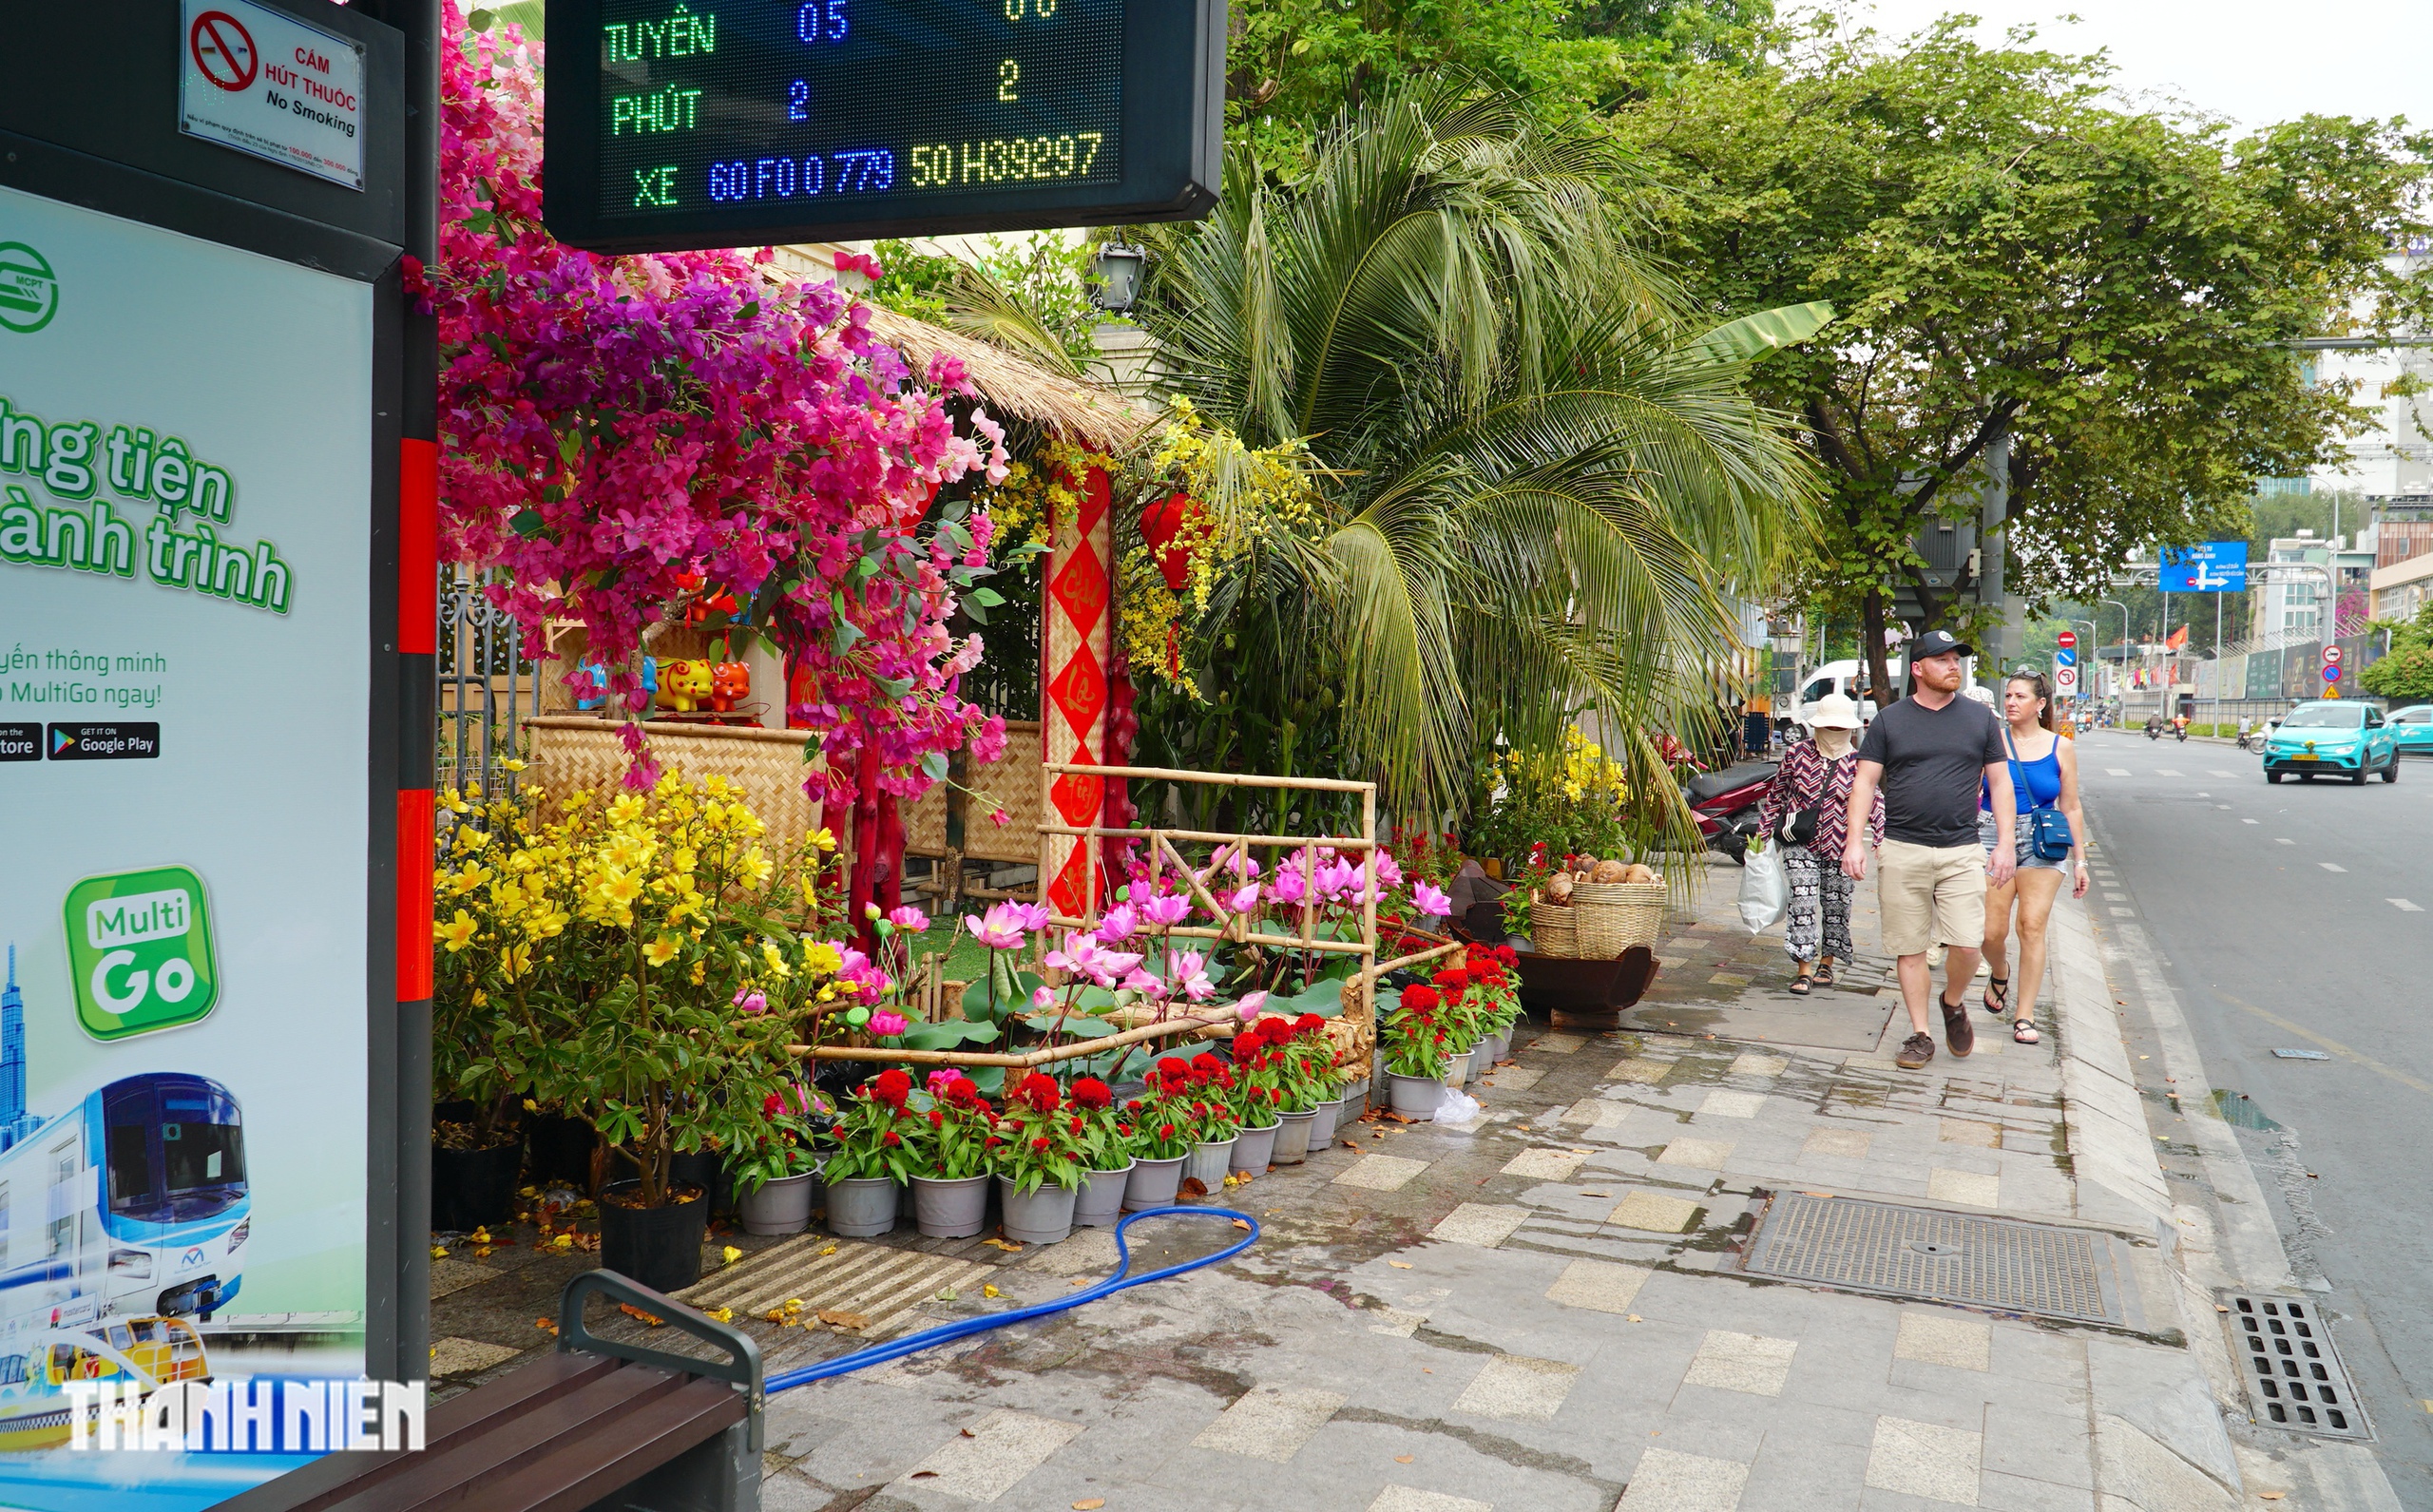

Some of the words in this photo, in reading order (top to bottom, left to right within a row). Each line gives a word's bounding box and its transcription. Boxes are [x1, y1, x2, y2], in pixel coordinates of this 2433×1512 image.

[295, 47, 330, 75] CẤM
[265, 62, 298, 89] HÚT
[302, 76, 357, 112] THUỐC
[614, 83, 703, 135] PHÚT
[789, 80, 808, 120] 2
[998, 59, 1020, 101] 2
[266, 89, 288, 110] No
[292, 100, 356, 138] Smoking
[288, 146, 313, 160] 100.000
[323, 159, 346, 172] 300.000
[634, 165, 679, 207] XE
[15, 275, 44, 289] MCPT
[105, 425, 231, 520] tiện
[147, 517, 289, 609] trình
[46, 648, 109, 677] thông
[116, 652, 166, 673] minh
[11, 681, 97, 703] MultiGo
[105, 684, 161, 709] ngay!
[1063, 661, 1096, 715] Là
[10, 728, 24, 737] the
[81, 737, 125, 755] Google
[128, 737, 154, 754] Play
[95, 896, 183, 941] Multi
[90, 949, 195, 1015] Go
